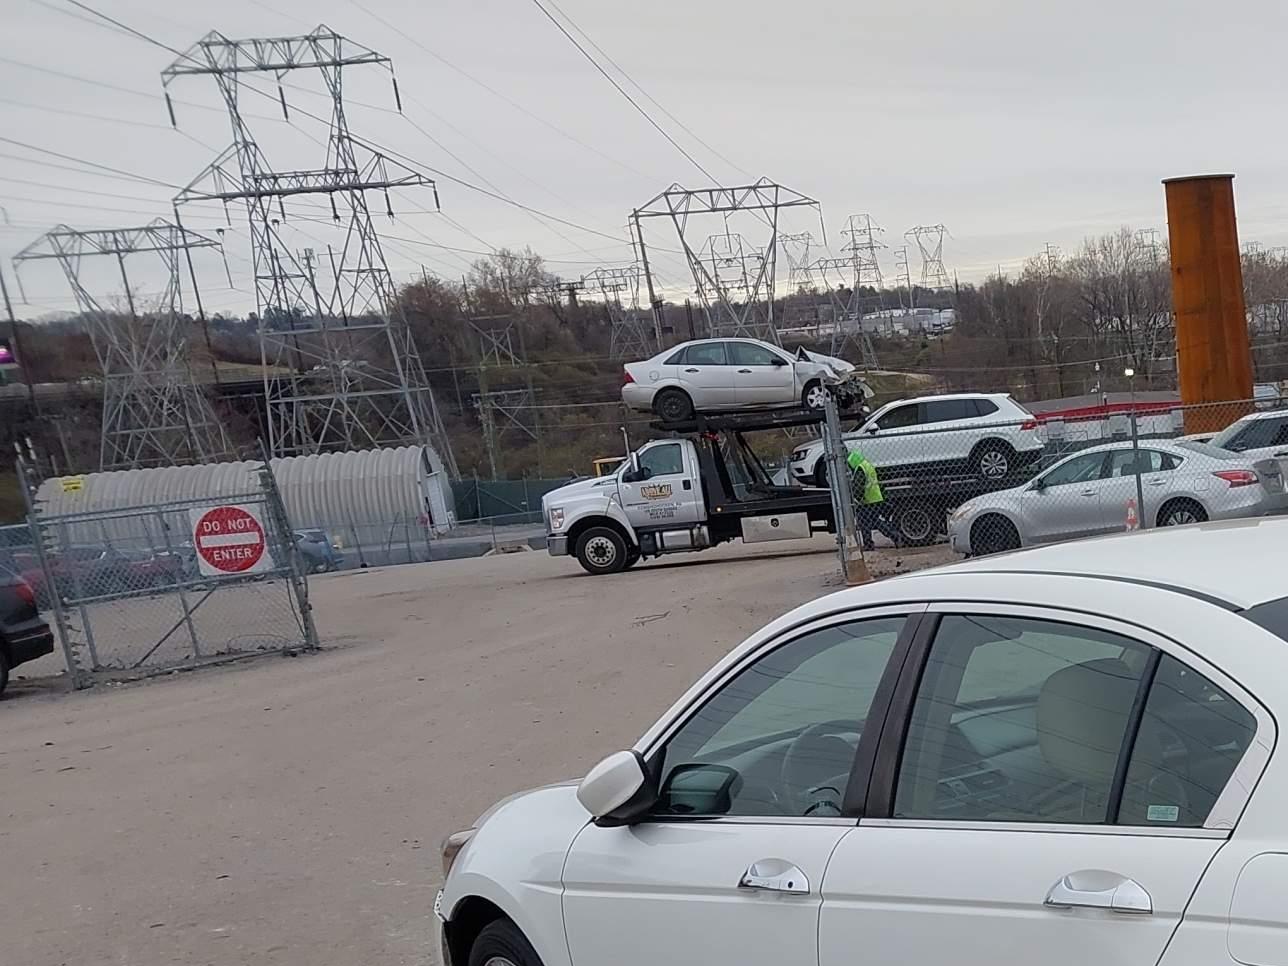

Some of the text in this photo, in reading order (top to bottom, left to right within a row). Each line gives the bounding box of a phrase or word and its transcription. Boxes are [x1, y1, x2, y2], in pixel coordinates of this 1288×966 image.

[203, 518, 252, 532] DO NOT
[213, 548, 252, 561] ENTER
